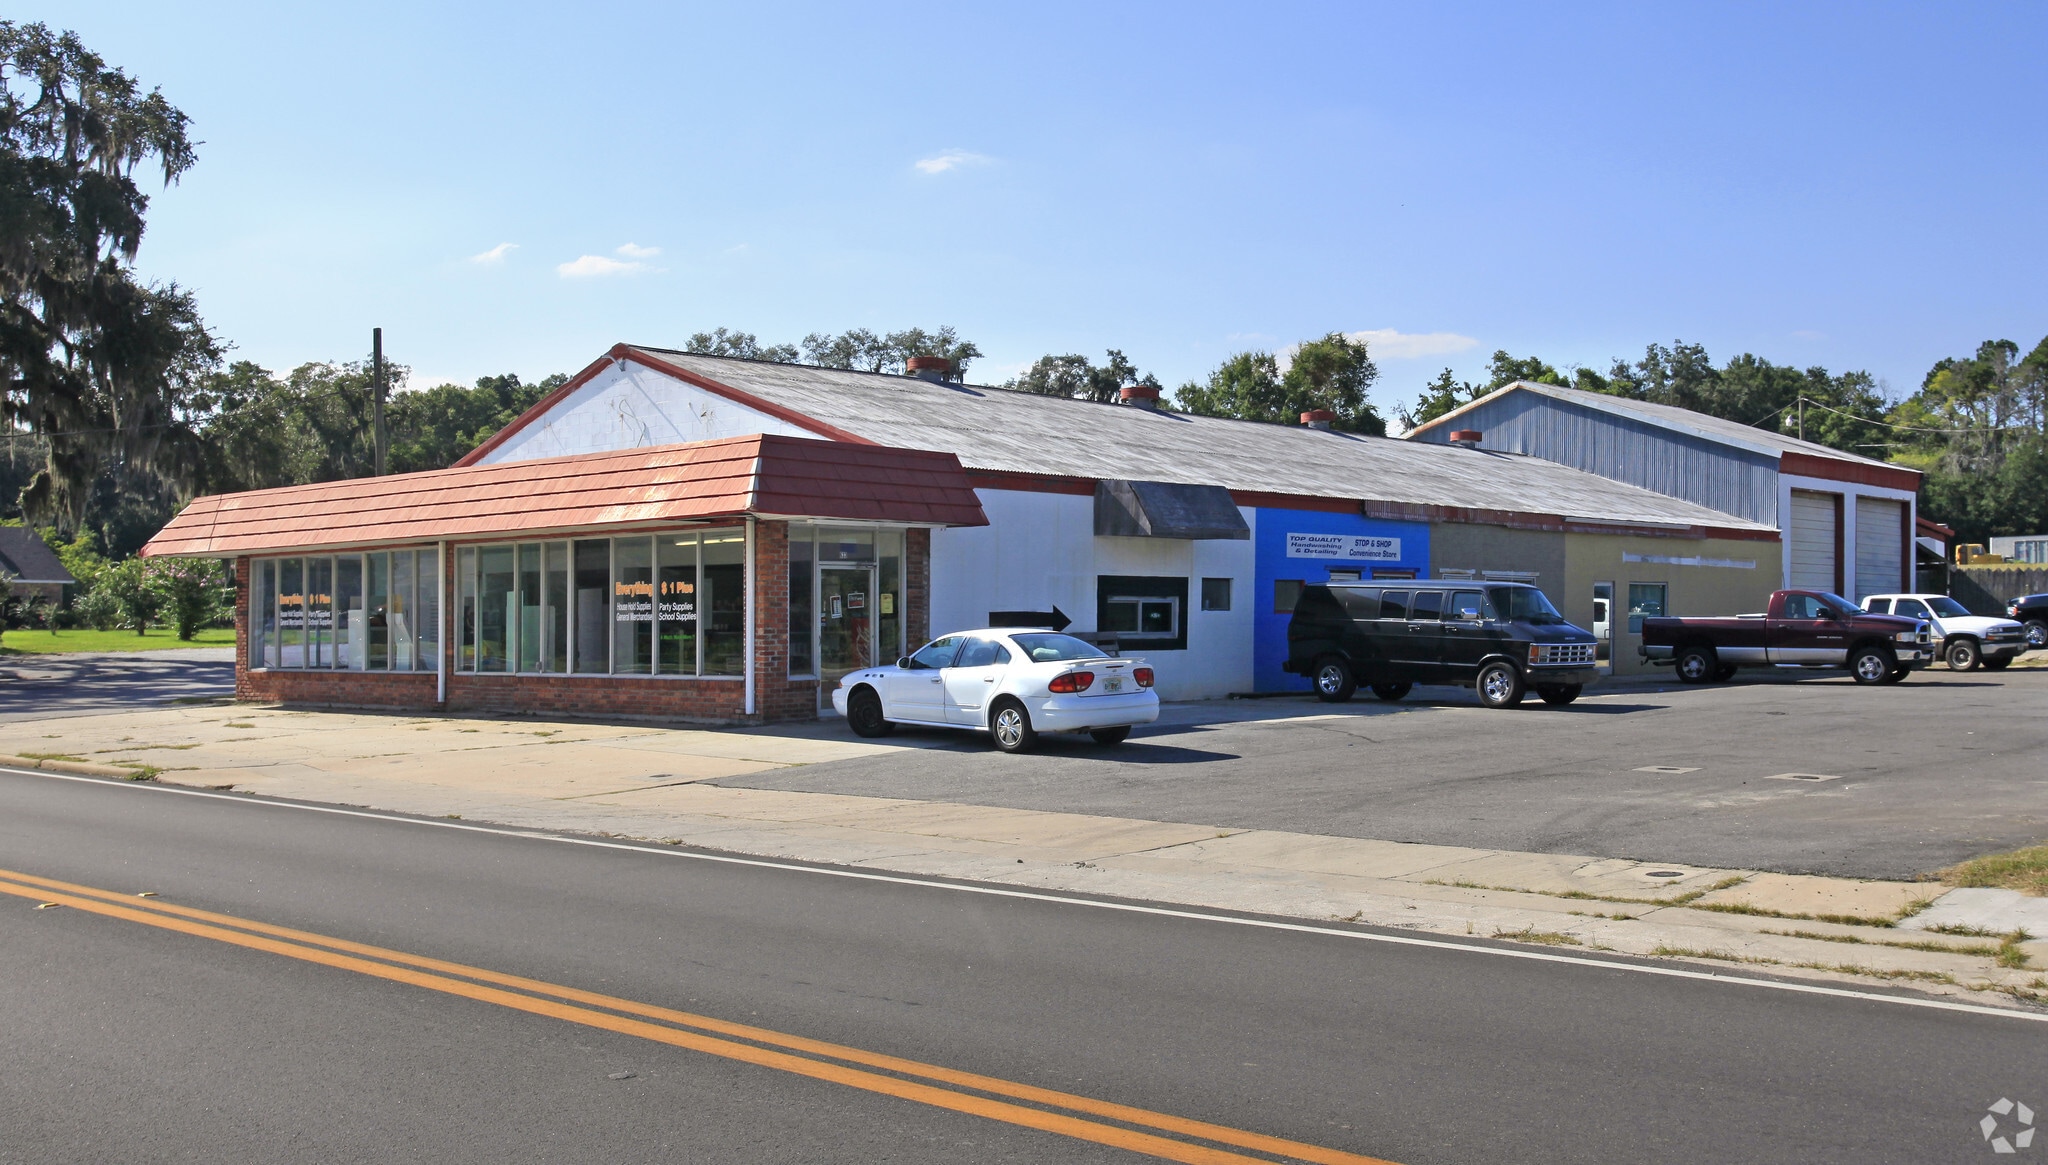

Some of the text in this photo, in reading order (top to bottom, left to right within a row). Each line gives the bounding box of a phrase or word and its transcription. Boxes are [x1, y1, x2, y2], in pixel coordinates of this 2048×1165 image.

[1291, 542, 1342, 550] Handwashing
[1304, 548, 1338, 556] Detailing
[1349, 549, 1397, 558] Convenience Store
[616, 581, 694, 598] Everything $ 1 Plus
[616, 602, 628, 610] House
[636, 602, 652, 612] Supplies
[659, 602, 692, 612] Party Supplies
[658, 612, 696, 621] School Supplies
